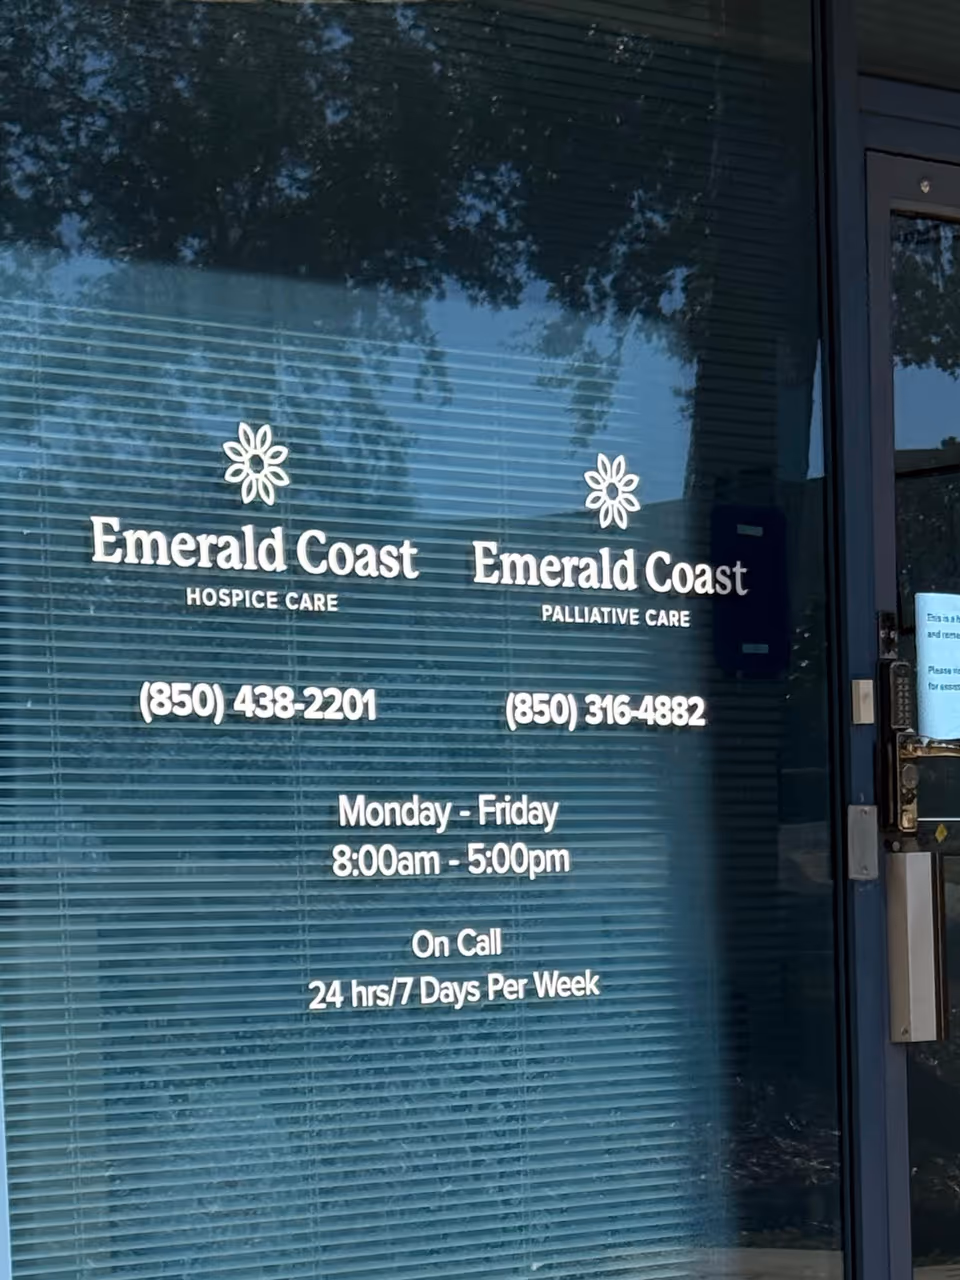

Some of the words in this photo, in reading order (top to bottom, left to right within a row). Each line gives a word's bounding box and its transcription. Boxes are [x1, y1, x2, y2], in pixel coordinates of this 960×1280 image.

[90, 515, 288, 572] Emerald
[296, 529, 420, 579] Coast
[472, 541, 638, 591] Emerald
[645, 550, 750, 597] Coast
[186, 587, 279, 610] HOSPICE
[285, 591, 339, 612] CARE
[541, 604, 640, 626] PALLIATIVE
[645, 609, 691, 628] CARE
[928, 665, 951, 675] Please
[139, 681, 225, 725] (850)
[232, 684, 378, 722] 438-2201
[505, 690, 578, 732] (850)
[584, 693, 707, 728] 316-4882
[338, 793, 453, 834] Monday
[478, 793, 560, 833] Friday
[332, 843, 440, 877] 8:00am
[467, 842, 571, 881] 5:00pm
[412, 929, 450, 958] On
[457, 927, 502, 957] Call
[308, 979, 344, 1010] 24
[351, 974, 414, 1009] hrs/7
[420, 974, 481, 1010] Days
[487, 972, 529, 1001] Per
[532, 968, 601, 998] Week
